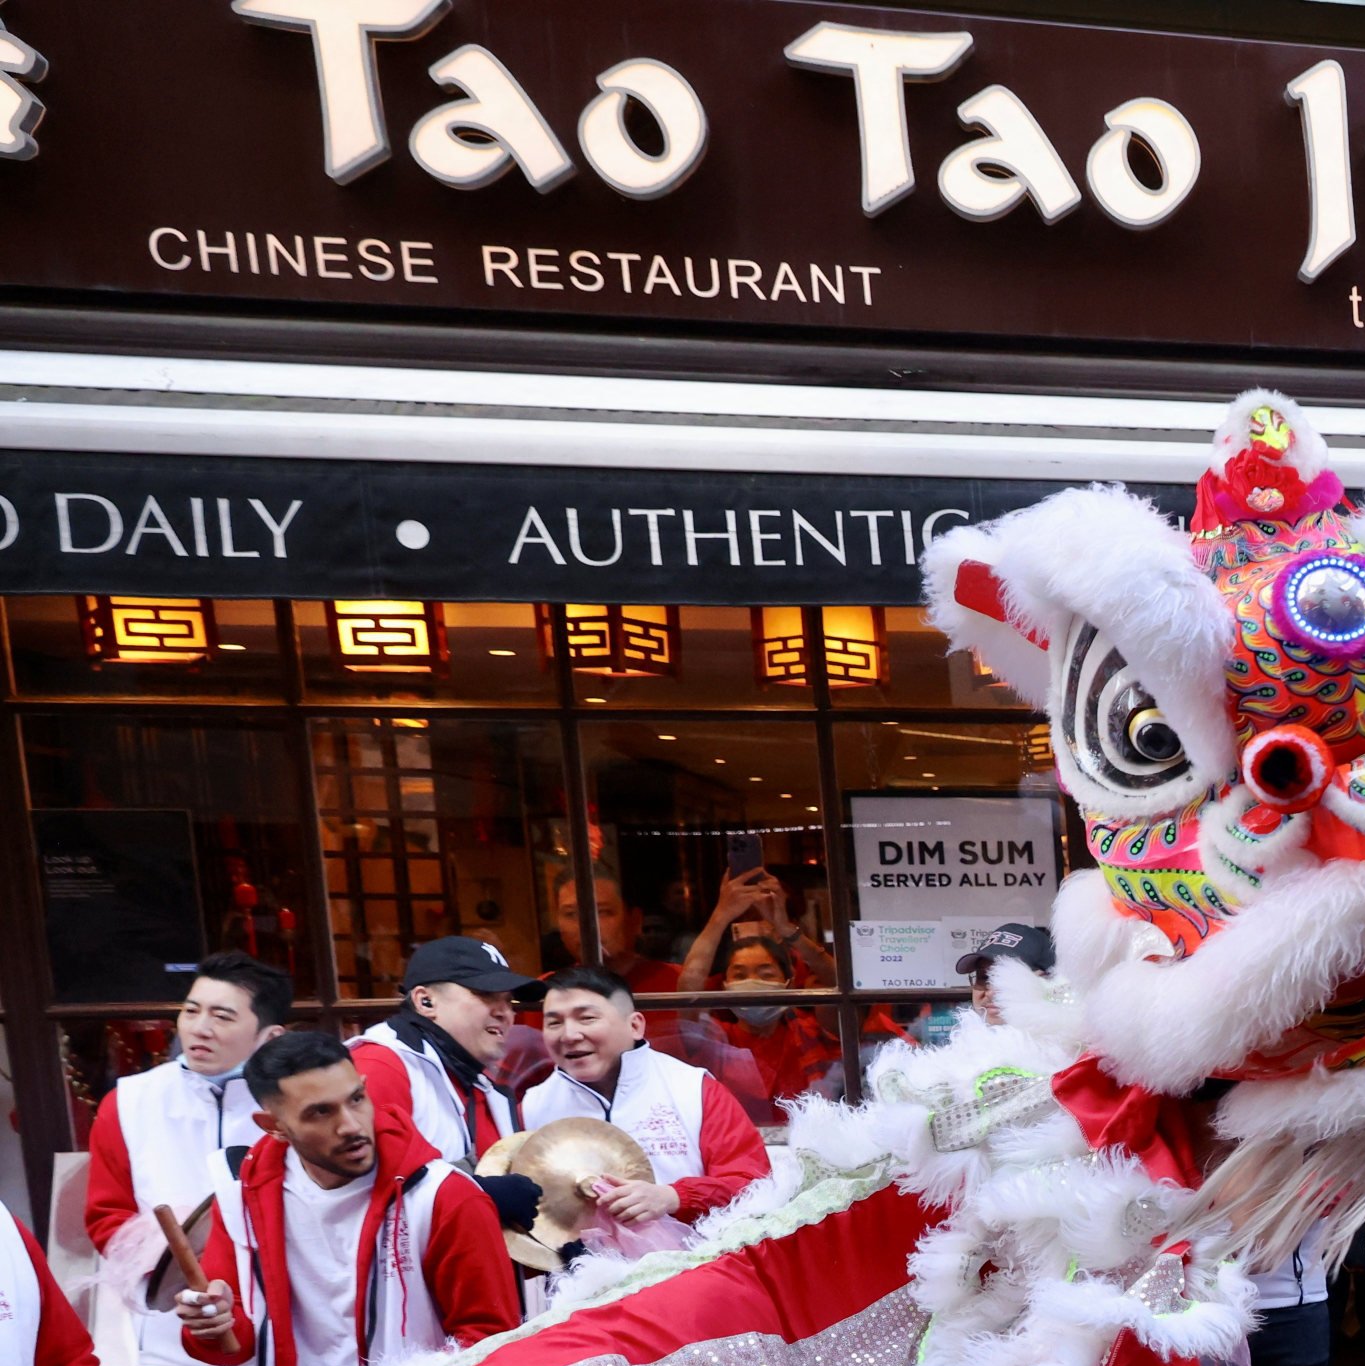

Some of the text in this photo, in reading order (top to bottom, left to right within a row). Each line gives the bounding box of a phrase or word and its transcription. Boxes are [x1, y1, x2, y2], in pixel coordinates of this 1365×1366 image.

[231, 0, 708, 200] Tao
[784, 21, 1201, 231] Tao
[149, 227, 882, 305] CHINESE RESTAURANT
[55, 492, 303, 558] DAILY
[878, 840, 1035, 866] DIM SUM
[870, 872, 1046, 888] SERVED ALL DAY
[878, 926, 936, 935] Tripadvisor
[880, 944, 916, 953] Choice
[882, 979, 936, 987] TAO TAO JU
